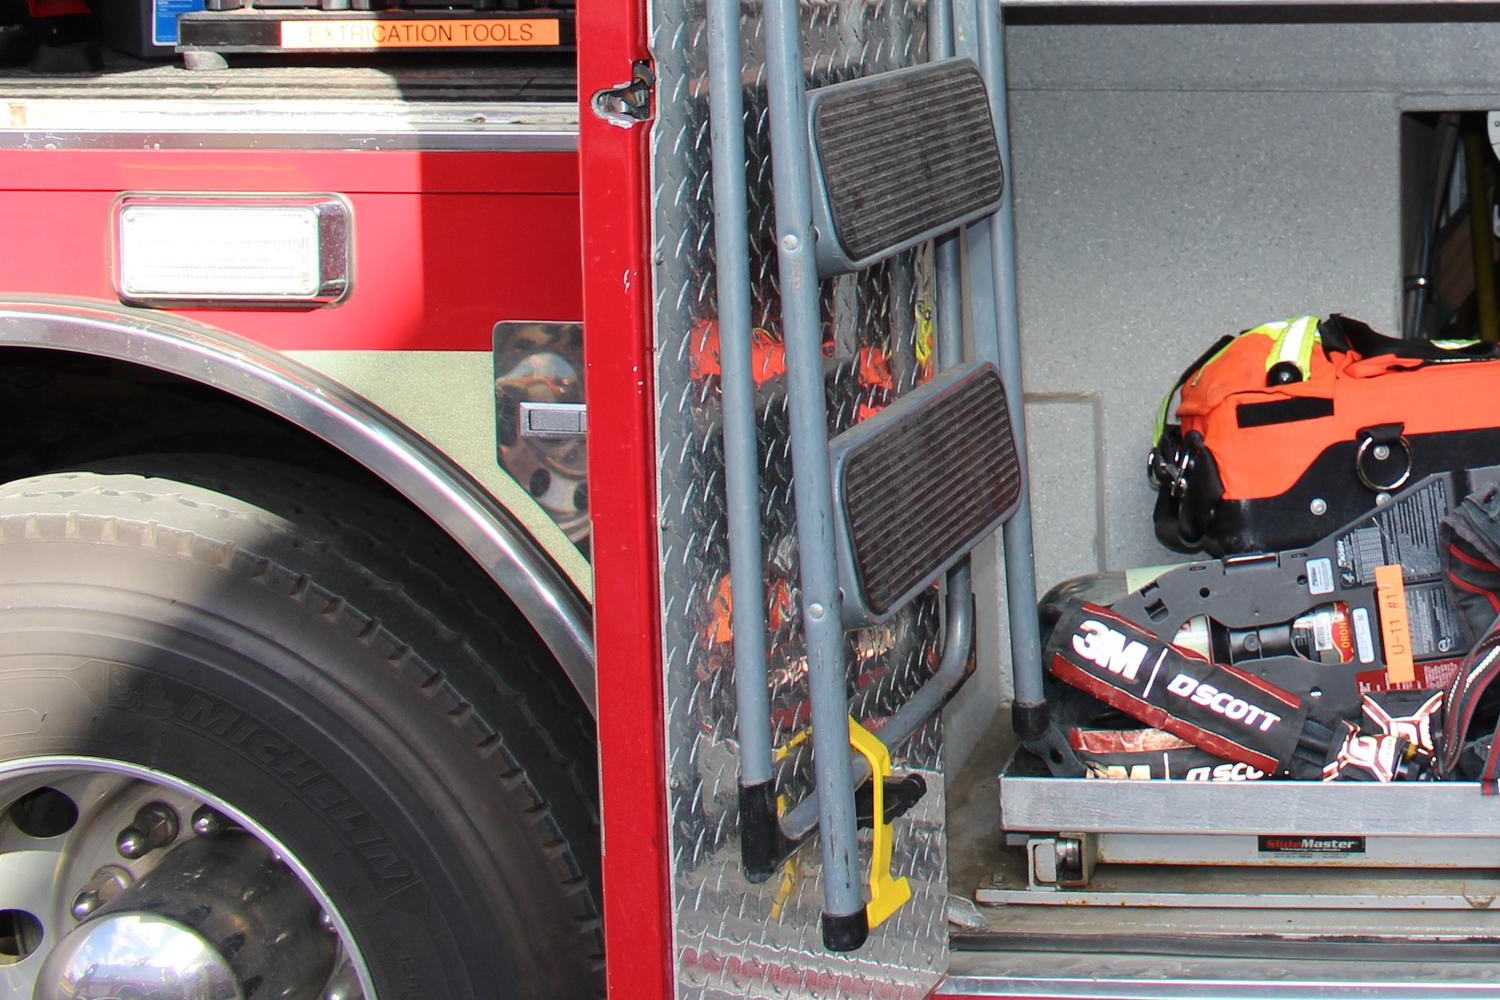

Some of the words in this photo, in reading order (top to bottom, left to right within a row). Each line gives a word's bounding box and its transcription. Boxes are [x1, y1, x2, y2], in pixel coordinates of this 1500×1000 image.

[308, 23, 452, 43] EXTRICATION
[460, 23, 533, 42] TOOLS
[1072, 619, 1149, 681] 3M
[1389, 620, 1405, 655] U-11
[177, 696, 408, 882] MICHELIN
